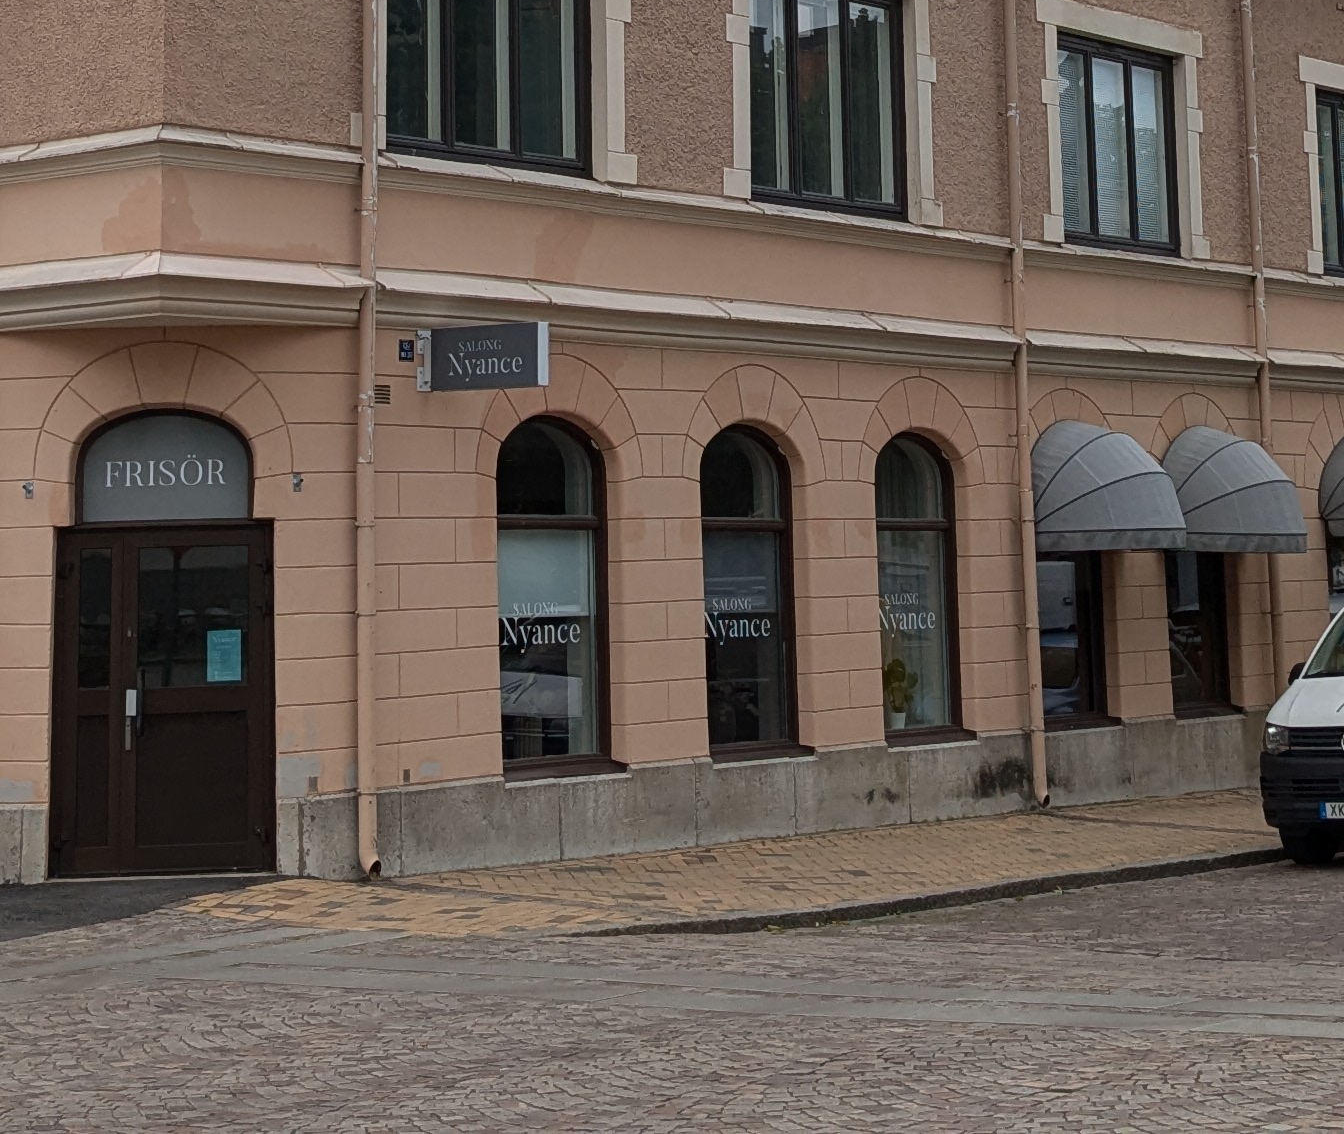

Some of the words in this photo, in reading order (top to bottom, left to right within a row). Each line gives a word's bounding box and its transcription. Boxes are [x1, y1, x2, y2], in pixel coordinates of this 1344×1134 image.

[458, 339, 502, 352] SALONG
[448, 353, 523, 382] Nyance
[105, 454, 226, 487] FRISÖR
[513, 601, 558, 616] SALONG
[712, 598, 752, 611] SALONG
[884, 592, 919, 605] SALONG
[500, 616, 581, 654] Nyance
[703, 611, 771, 646] Nyance
[878, 605, 936, 638] Nyance
